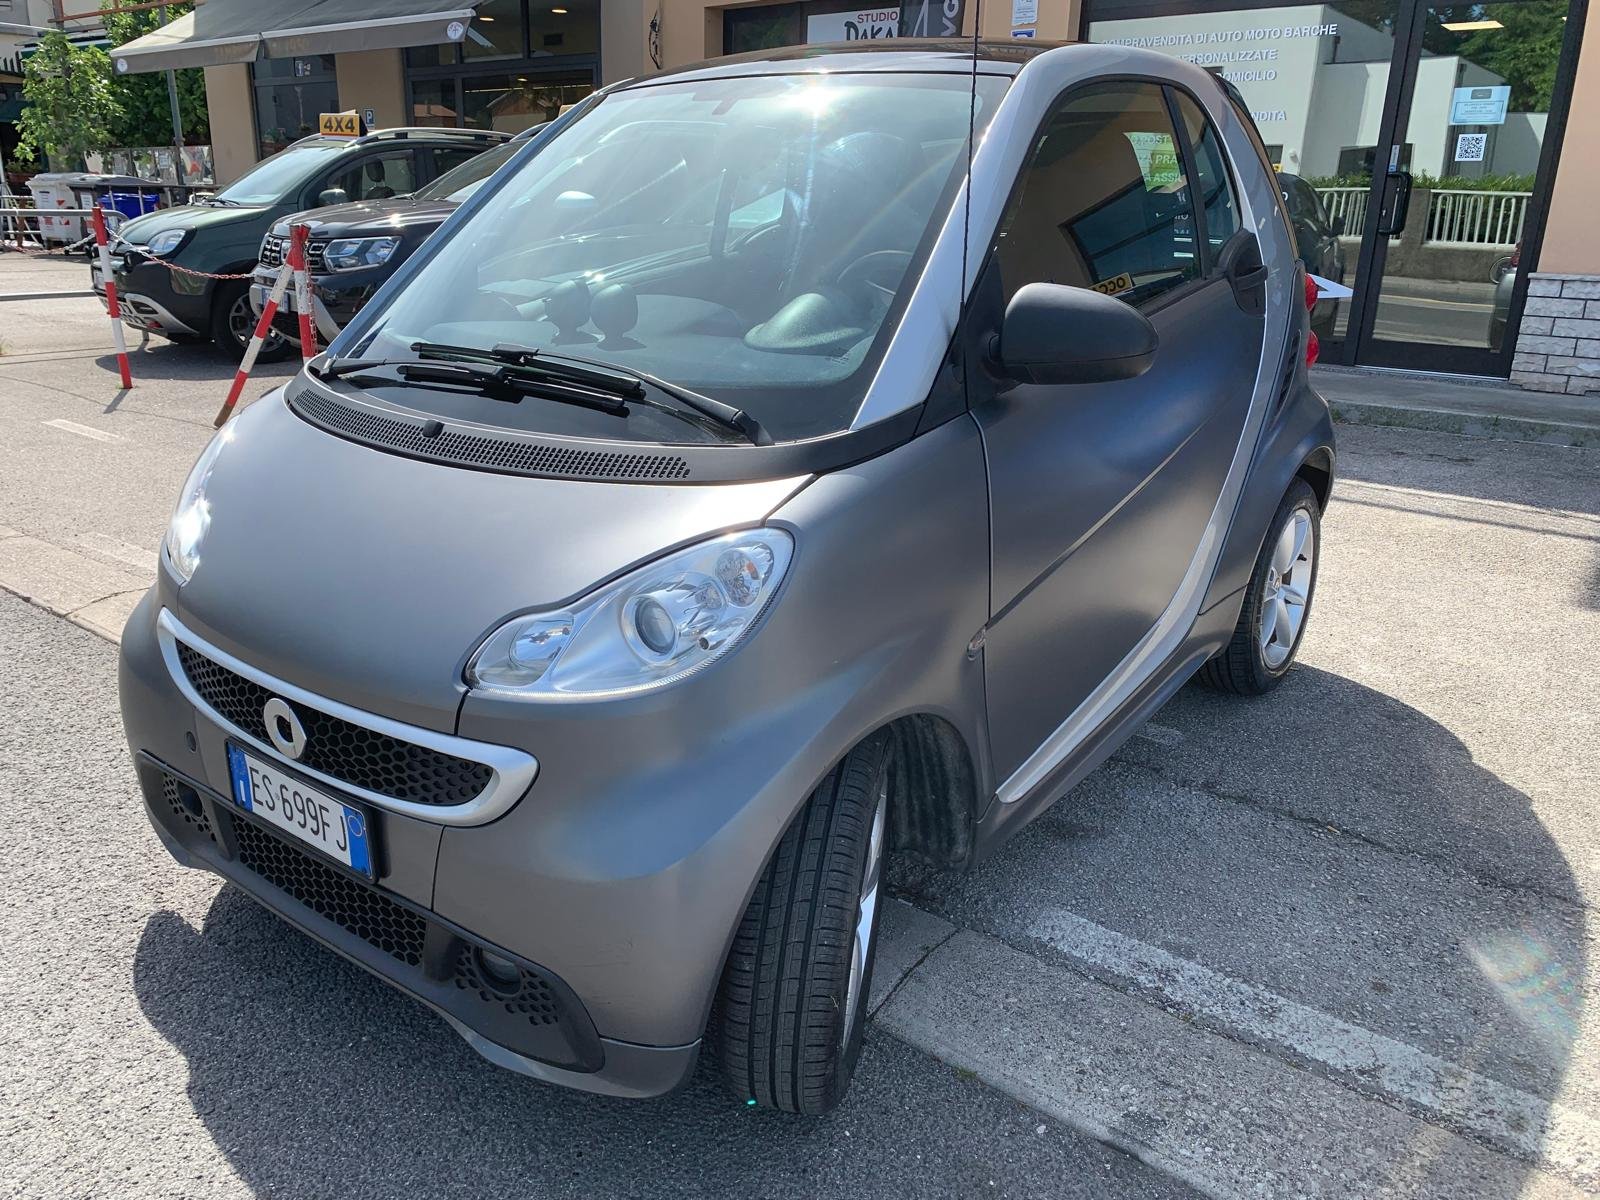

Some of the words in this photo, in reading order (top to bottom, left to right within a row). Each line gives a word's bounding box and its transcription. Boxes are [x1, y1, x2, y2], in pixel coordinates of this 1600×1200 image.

[857, 11, 898, 24] STUDIO
[844, 20, 899, 41] DAKA
[1195, 33, 1206, 44] DI
[1210, 30, 1243, 42] AUTO
[1245, 27, 1281, 41] MOTO
[1284, 23, 1338, 38] BARCHE
[323, 117, 355, 133] 4X4
